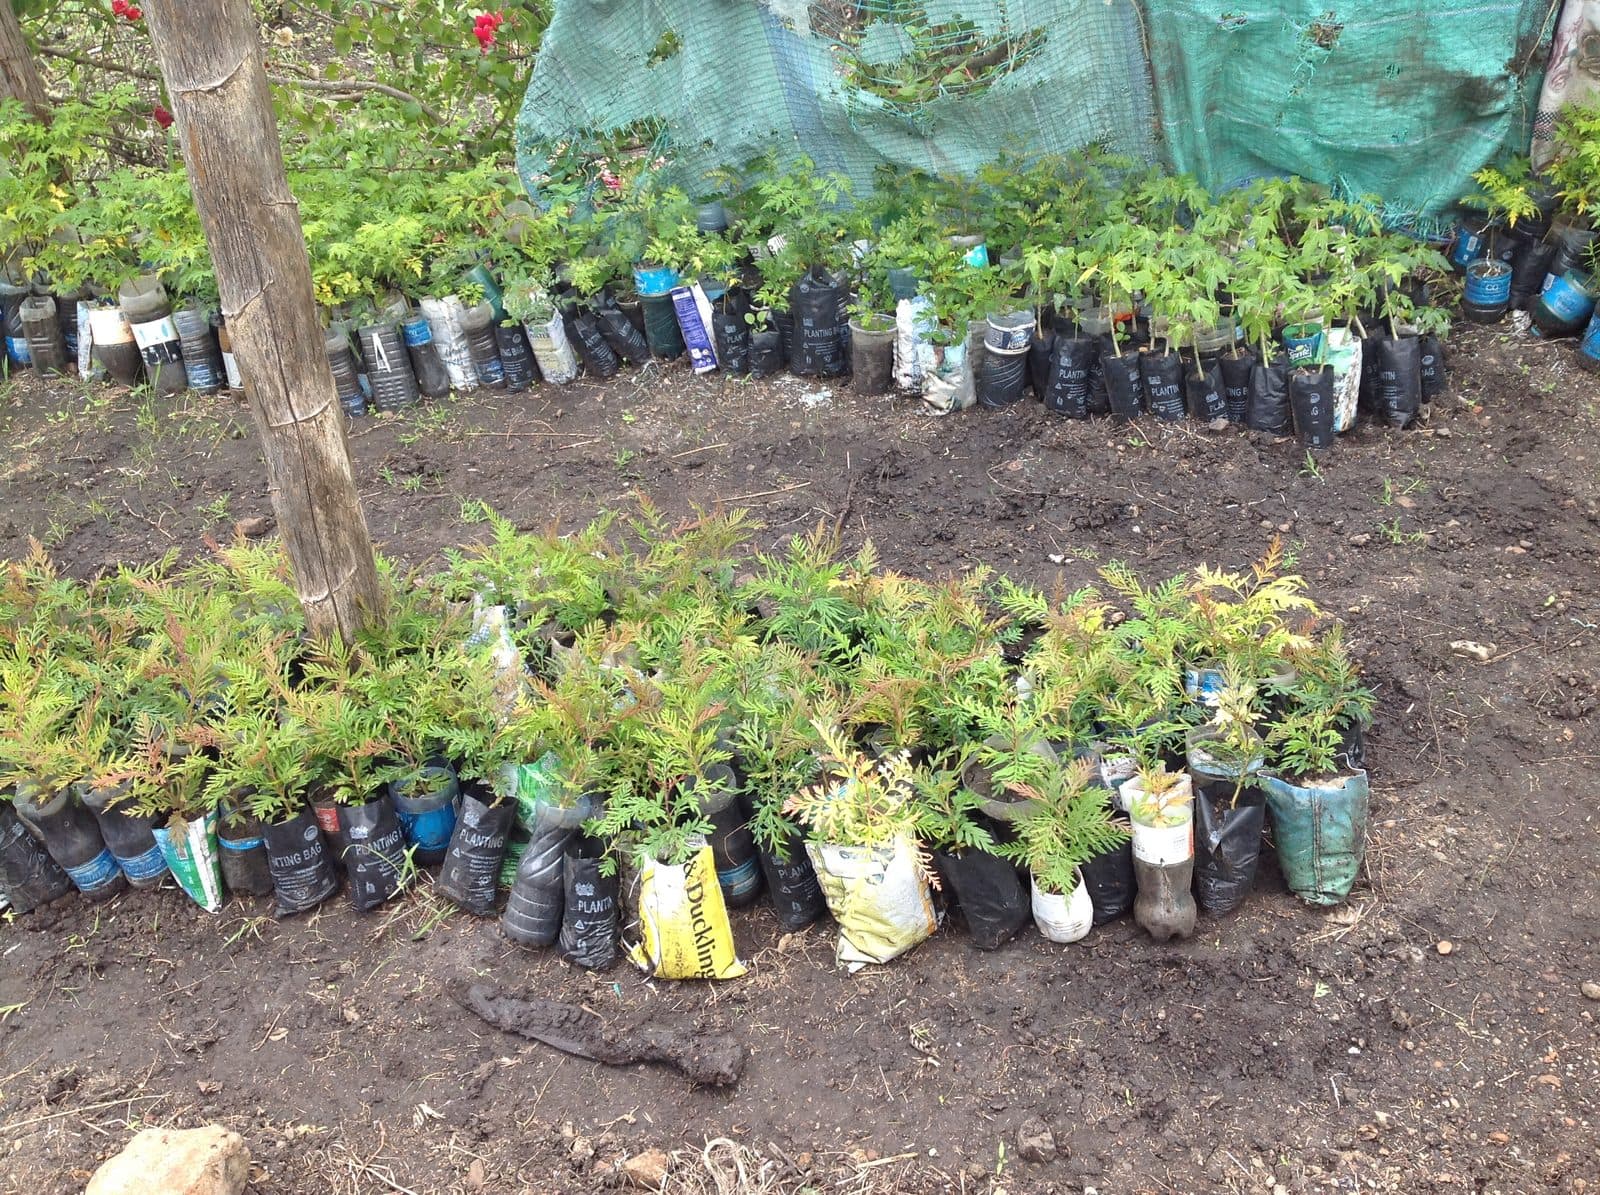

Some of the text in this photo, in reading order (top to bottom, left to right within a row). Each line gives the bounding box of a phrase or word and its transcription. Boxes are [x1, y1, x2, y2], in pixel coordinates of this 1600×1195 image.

[803, 328, 834, 339] PLANTING
[355, 830, 399, 857] PLANTING
[459, 828, 505, 849] PLANTING
[302, 841, 322, 861] BAG
[682, 859, 699, 879] &
